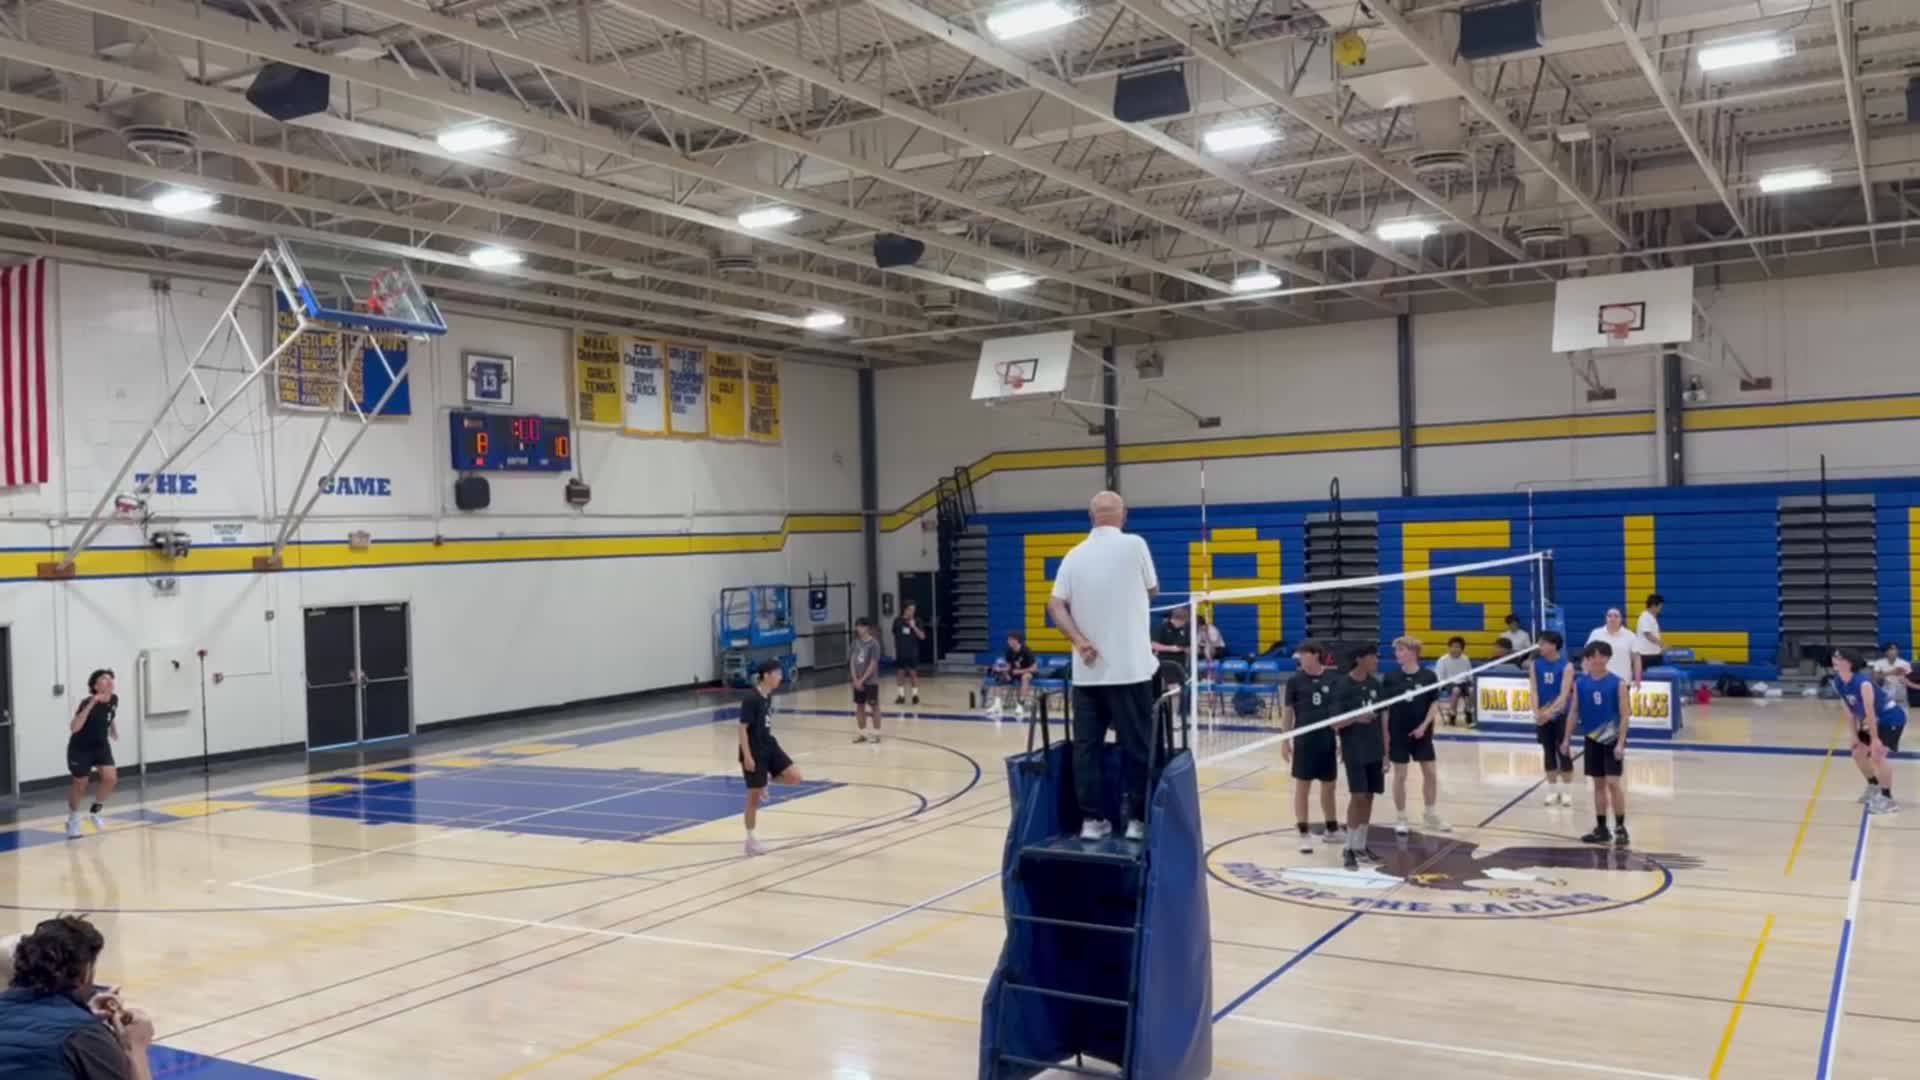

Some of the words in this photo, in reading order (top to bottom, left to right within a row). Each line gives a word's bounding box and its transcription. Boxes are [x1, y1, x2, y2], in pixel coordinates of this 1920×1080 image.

[482, 375, 498, 391] 13
[135, 473, 198, 495] THE
[318, 474, 392, 497] GAME
[1481, 688, 1508, 711] OAK
[1593, 691, 1602, 705] 9
[1283, 888, 1338, 900] OF
[1350, 896, 1432, 913] THE
[1451, 892, 1611, 914] EAGLES
